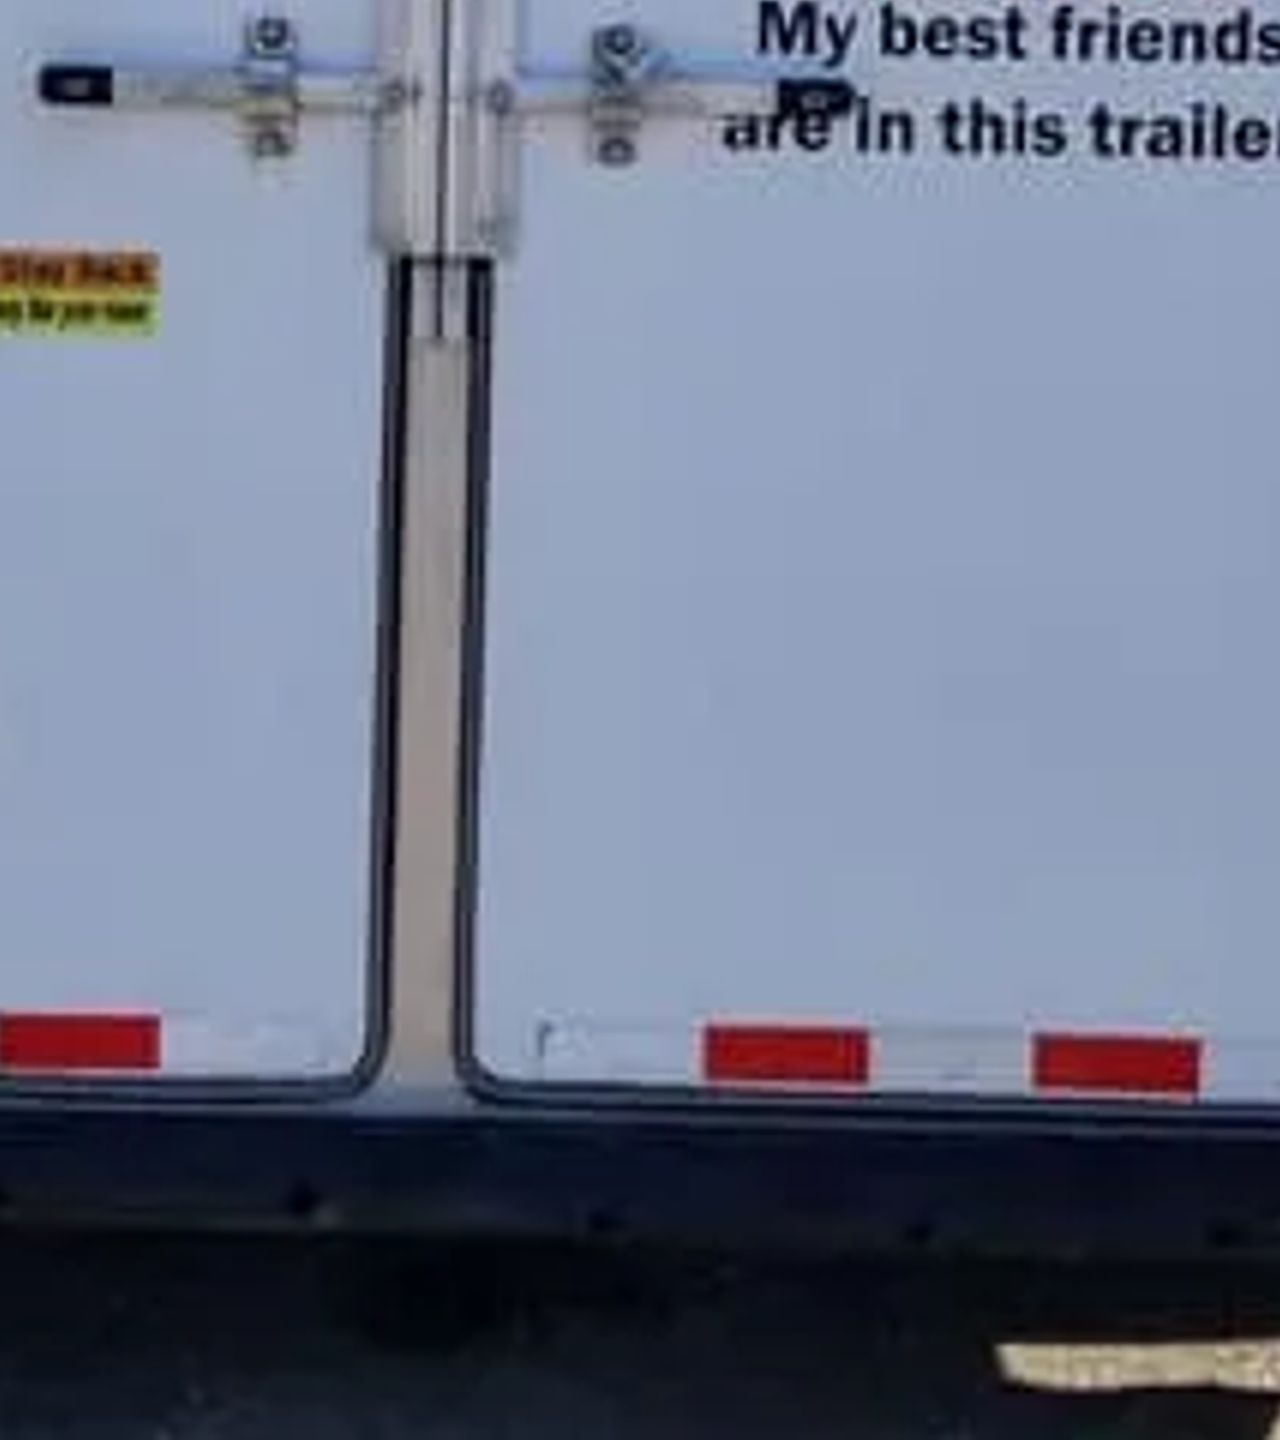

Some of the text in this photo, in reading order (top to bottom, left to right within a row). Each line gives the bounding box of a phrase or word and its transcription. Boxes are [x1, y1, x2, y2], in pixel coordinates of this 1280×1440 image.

[756, 0, 859, 68] My
[880, 4, 1028, 60] best
[722, 105, 831, 152] are
[856, 96, 915, 152] in
[939, 99, 1068, 157] this
